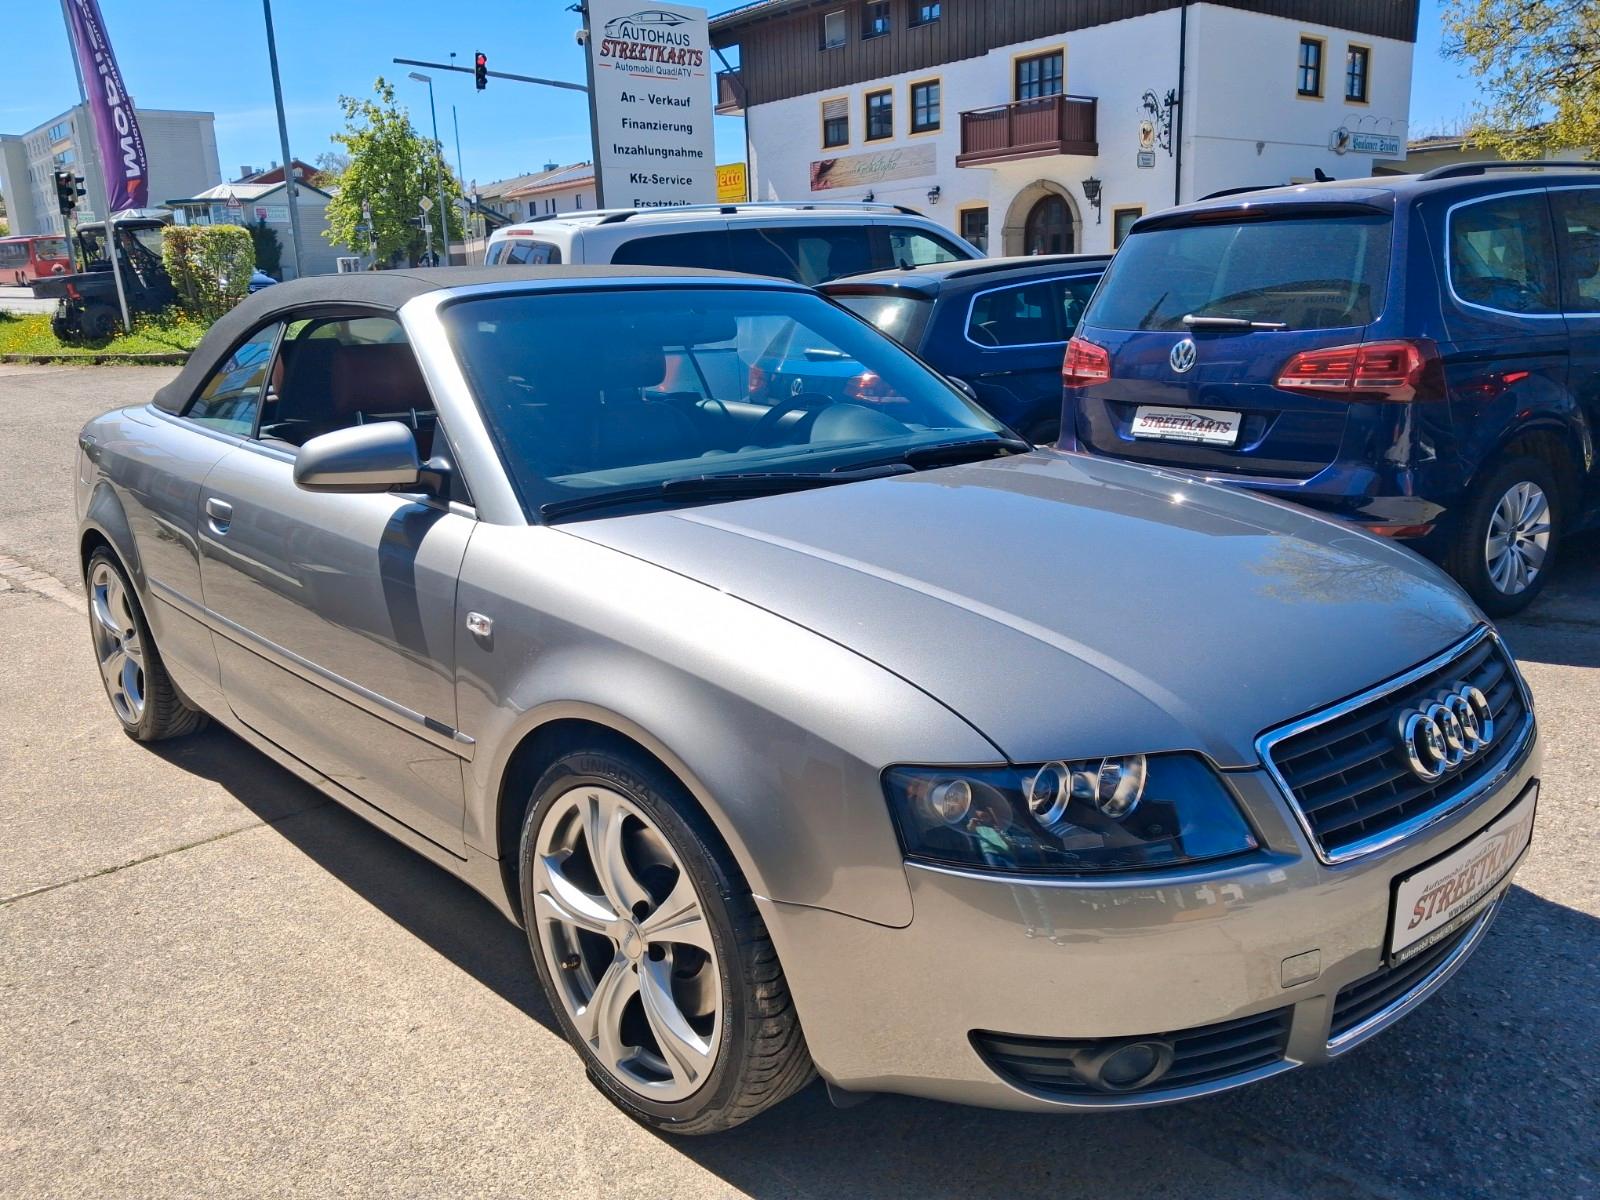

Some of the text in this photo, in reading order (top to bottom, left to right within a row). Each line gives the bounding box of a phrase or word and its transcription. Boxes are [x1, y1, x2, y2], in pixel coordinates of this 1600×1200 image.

[622, 26, 690, 47] AUTOHAUS
[600, 38, 703, 67] STREETKARTS
[615, 61, 654, 73] Automobil
[620, 91, 636, 103] An
[648, 93, 691, 107] Verkauf
[621, 118, 693, 135] Finanzierung
[613, 143, 703, 159] Inzahlungnahme
[630, 173, 693, 186] Kfz-Service
[1140, 416, 1232, 433] STREETKARTS
[1401, 939, 1430, 961] Automobil
